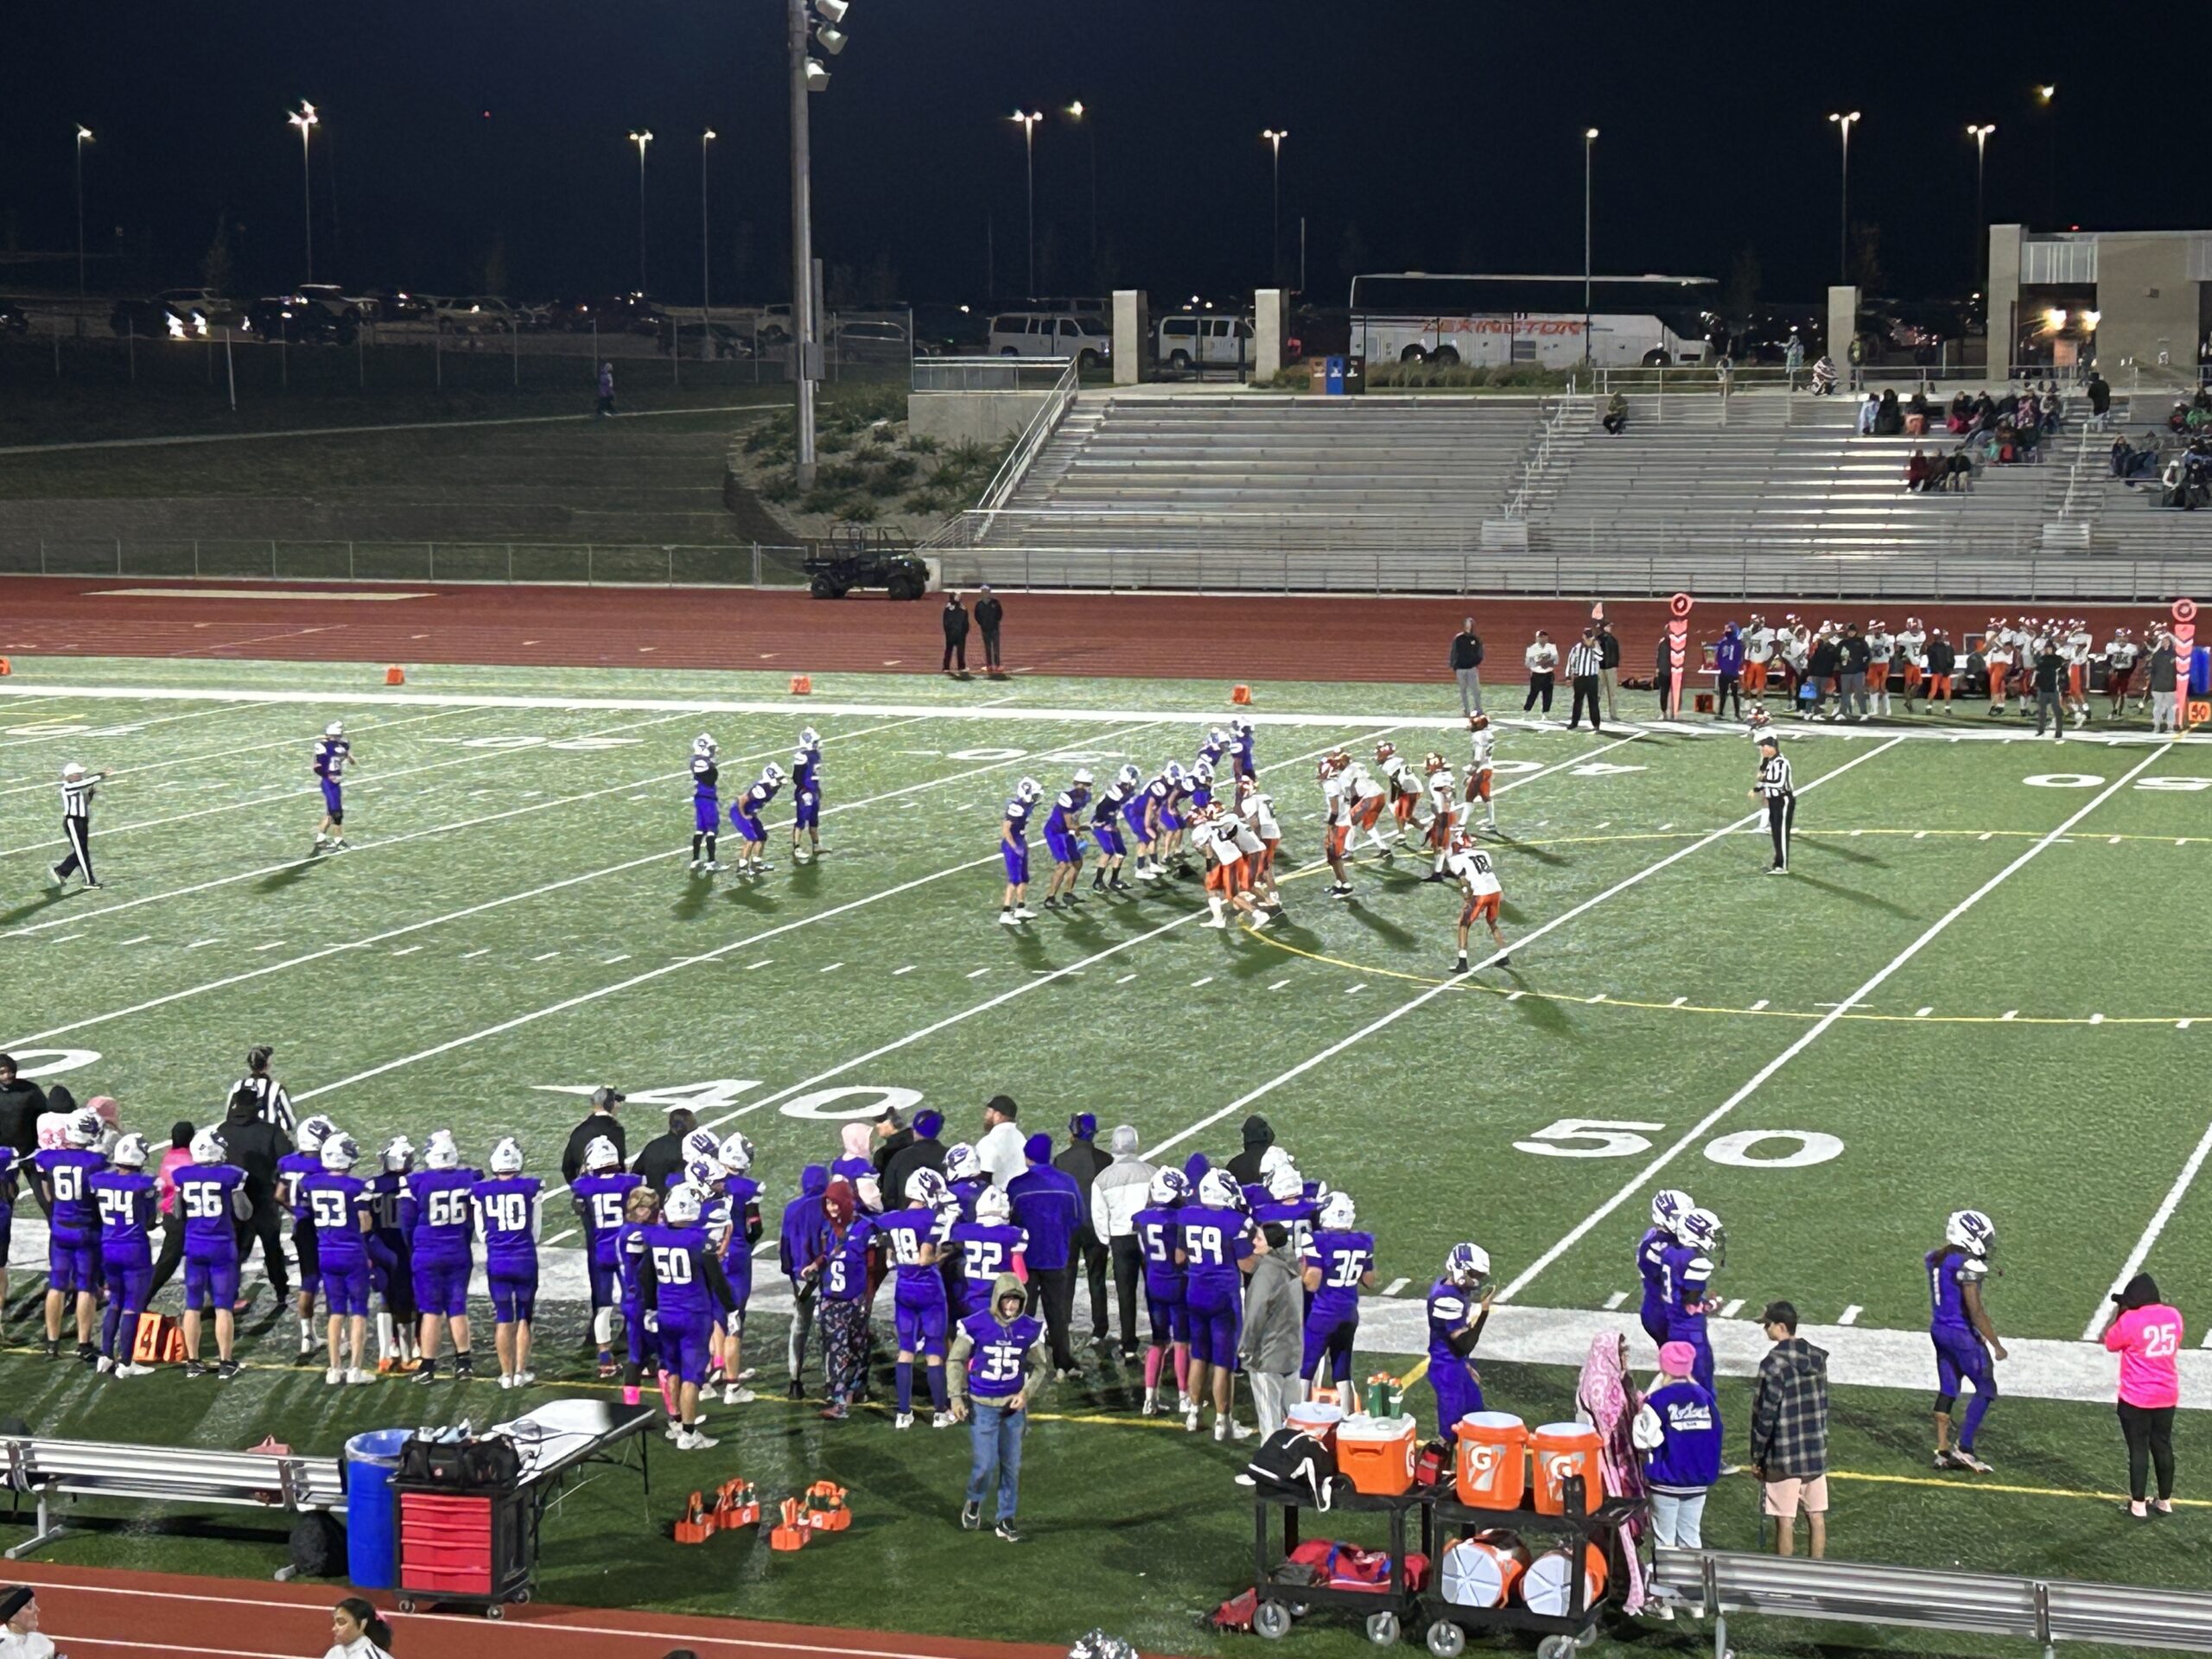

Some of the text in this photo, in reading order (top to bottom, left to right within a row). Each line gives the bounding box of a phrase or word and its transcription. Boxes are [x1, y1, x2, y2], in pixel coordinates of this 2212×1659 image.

[2190, 702, 2209, 720] 50
[1512, 1119, 1845, 1168] 50
[53, 1166, 83, 1201] 61
[183, 1181, 222, 1217] 56
[98, 1188, 134, 1225] 24
[311, 1191, 347, 1227] 53
[429, 1189, 468, 1226] 66
[486, 1194, 526, 1231] 40
[592, 1193, 623, 1229] 15
[890, 1228, 919, 1264] 18
[964, 1241, 1002, 1280] 22
[1185, 1225, 1223, 1265] 59
[652, 1247, 692, 1285] 50
[1326, 1249, 1366, 1287] 36
[2144, 1323, 2177, 1357] 25
[981, 1345, 1022, 1382] 35
[1471, 1446, 1492, 1471] G
[1549, 1455, 1572, 1480] G
